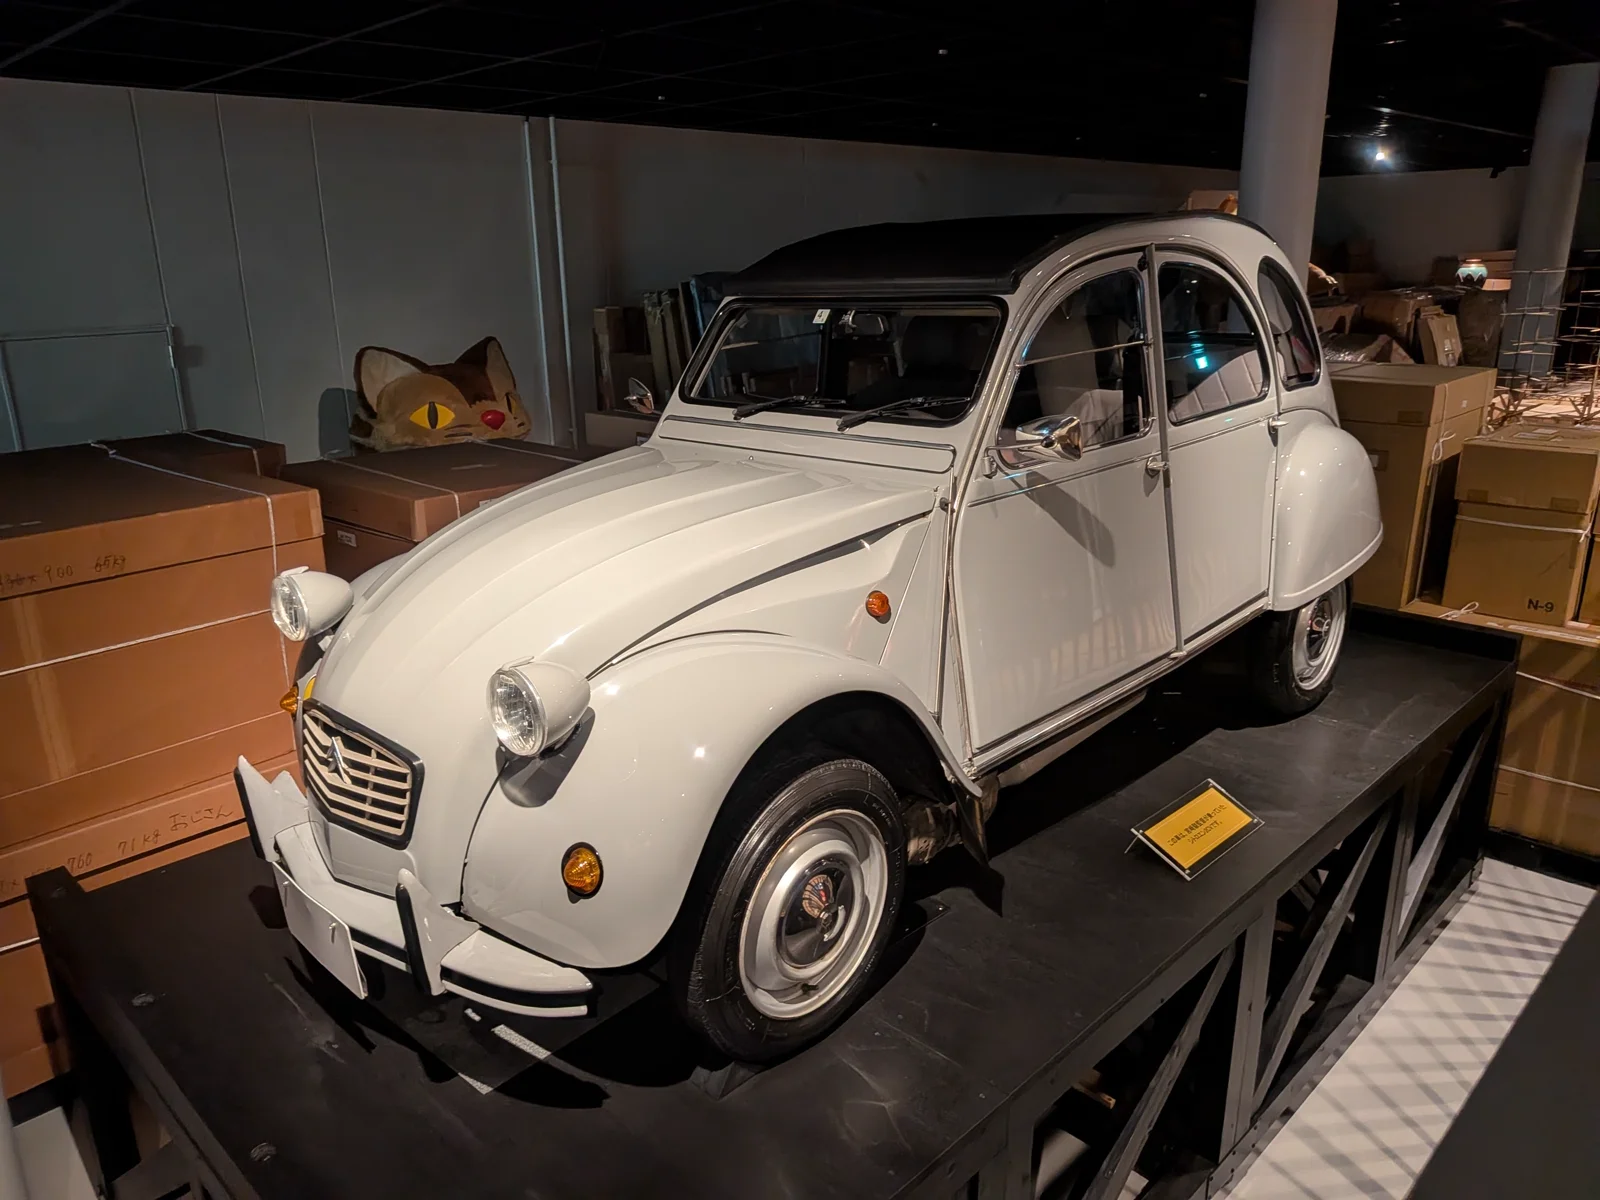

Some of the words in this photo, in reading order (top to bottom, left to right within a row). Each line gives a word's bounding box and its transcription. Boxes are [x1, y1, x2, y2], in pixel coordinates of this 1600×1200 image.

[1528, 598, 1554, 612] N-9
[67, 852, 93, 873] 760
[169, 805, 234, 832] おじさん
